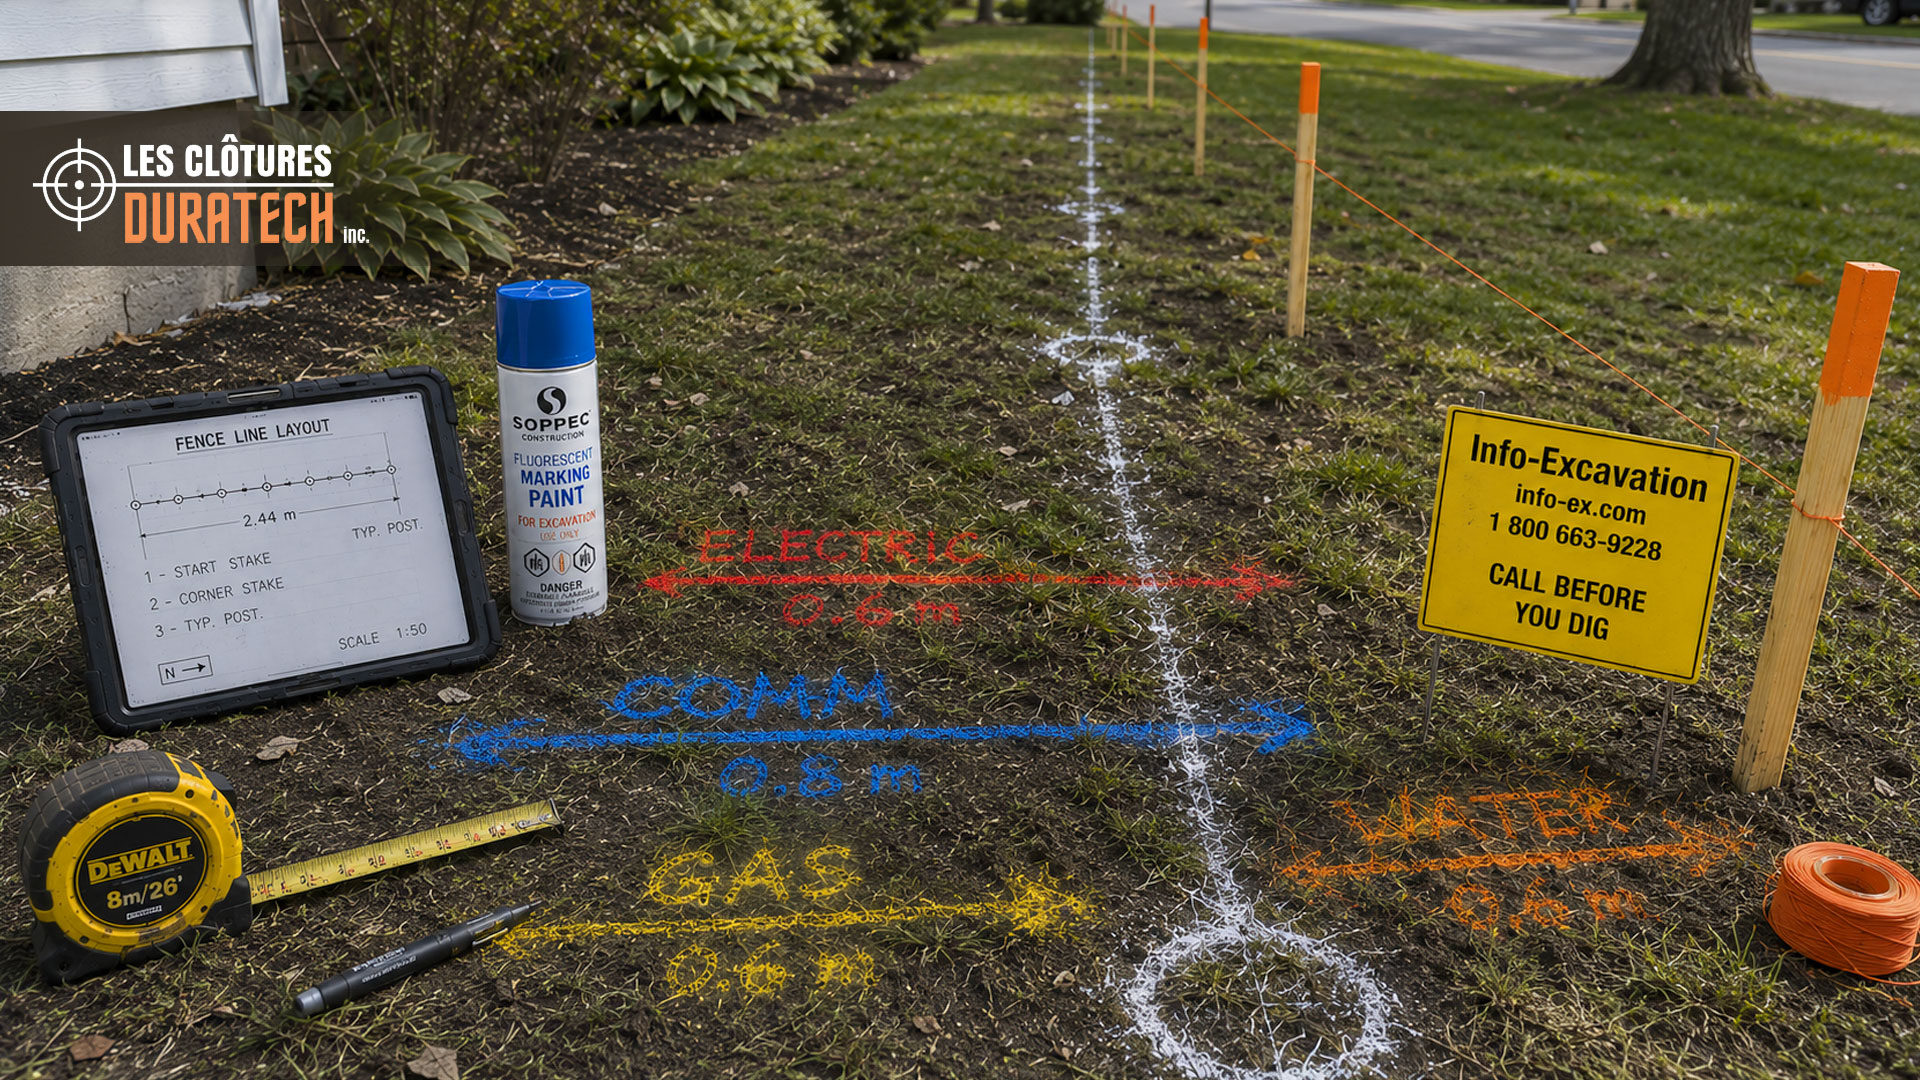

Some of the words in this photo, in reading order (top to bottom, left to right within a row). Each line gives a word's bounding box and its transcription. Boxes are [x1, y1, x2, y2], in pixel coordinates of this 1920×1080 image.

[175, 432, 224, 451] FENCE
[234, 427, 268, 444] LINE
[276, 418, 330, 439] LAYOUT
[513, 412, 590, 432] SOPPEC
[521, 430, 584, 442] CONSTRUCTION
[513, 446, 593, 467] FLUORESCENT
[1470, 433, 1708, 502] Info-Excavation
[521, 465, 590, 486] MARKING
[529, 485, 584, 508] PAINT
[1515, 484, 1647, 525] info-ex.com
[243, 511, 277, 528] 2.44
[284, 510, 296, 521] m
[352, 525, 380, 540] TYP.
[387, 518, 423, 535] POST.
[518, 515, 535, 528] FOR
[539, 509, 596, 528] EXCAVATION
[700, 529, 984, 563] ELECTRIC
[1490, 512, 1500, 531] 1
[1508, 515, 1549, 540] 800
[1556, 524, 1662, 561] 663-9228
[144, 571, 152, 584] 1
[174, 560, 217, 579] START
[229, 552, 271, 570] STAKE
[150, 598, 159, 611] 2
[179, 586, 234, 606] CORNER
[242, 577, 284, 595] STAKE
[540, 580, 583, 593] DANGER
[1489, 562, 1546, 593] CALL
[1554, 574, 1647, 613] BEFORE
[155, 625, 164, 638] 3
[184, 617, 215, 633] TYP.
[224, 608, 264, 625] POST.
[782, 592, 894, 626] 0.6
[914, 599, 961, 626] m
[1515, 601, 1561, 630] YOU
[1568, 612, 1610, 640] DIG
[338, 632, 380, 651] SCALE
[397, 622, 428, 639] 1:50
[165, 667, 176, 680] N
[611, 668, 893, 720] COMM
[719, 755, 843, 798] 0.8
[870, 761, 923, 796] m
[648, 844, 856, 906] GAS
[667, 940, 787, 994] 0.6
